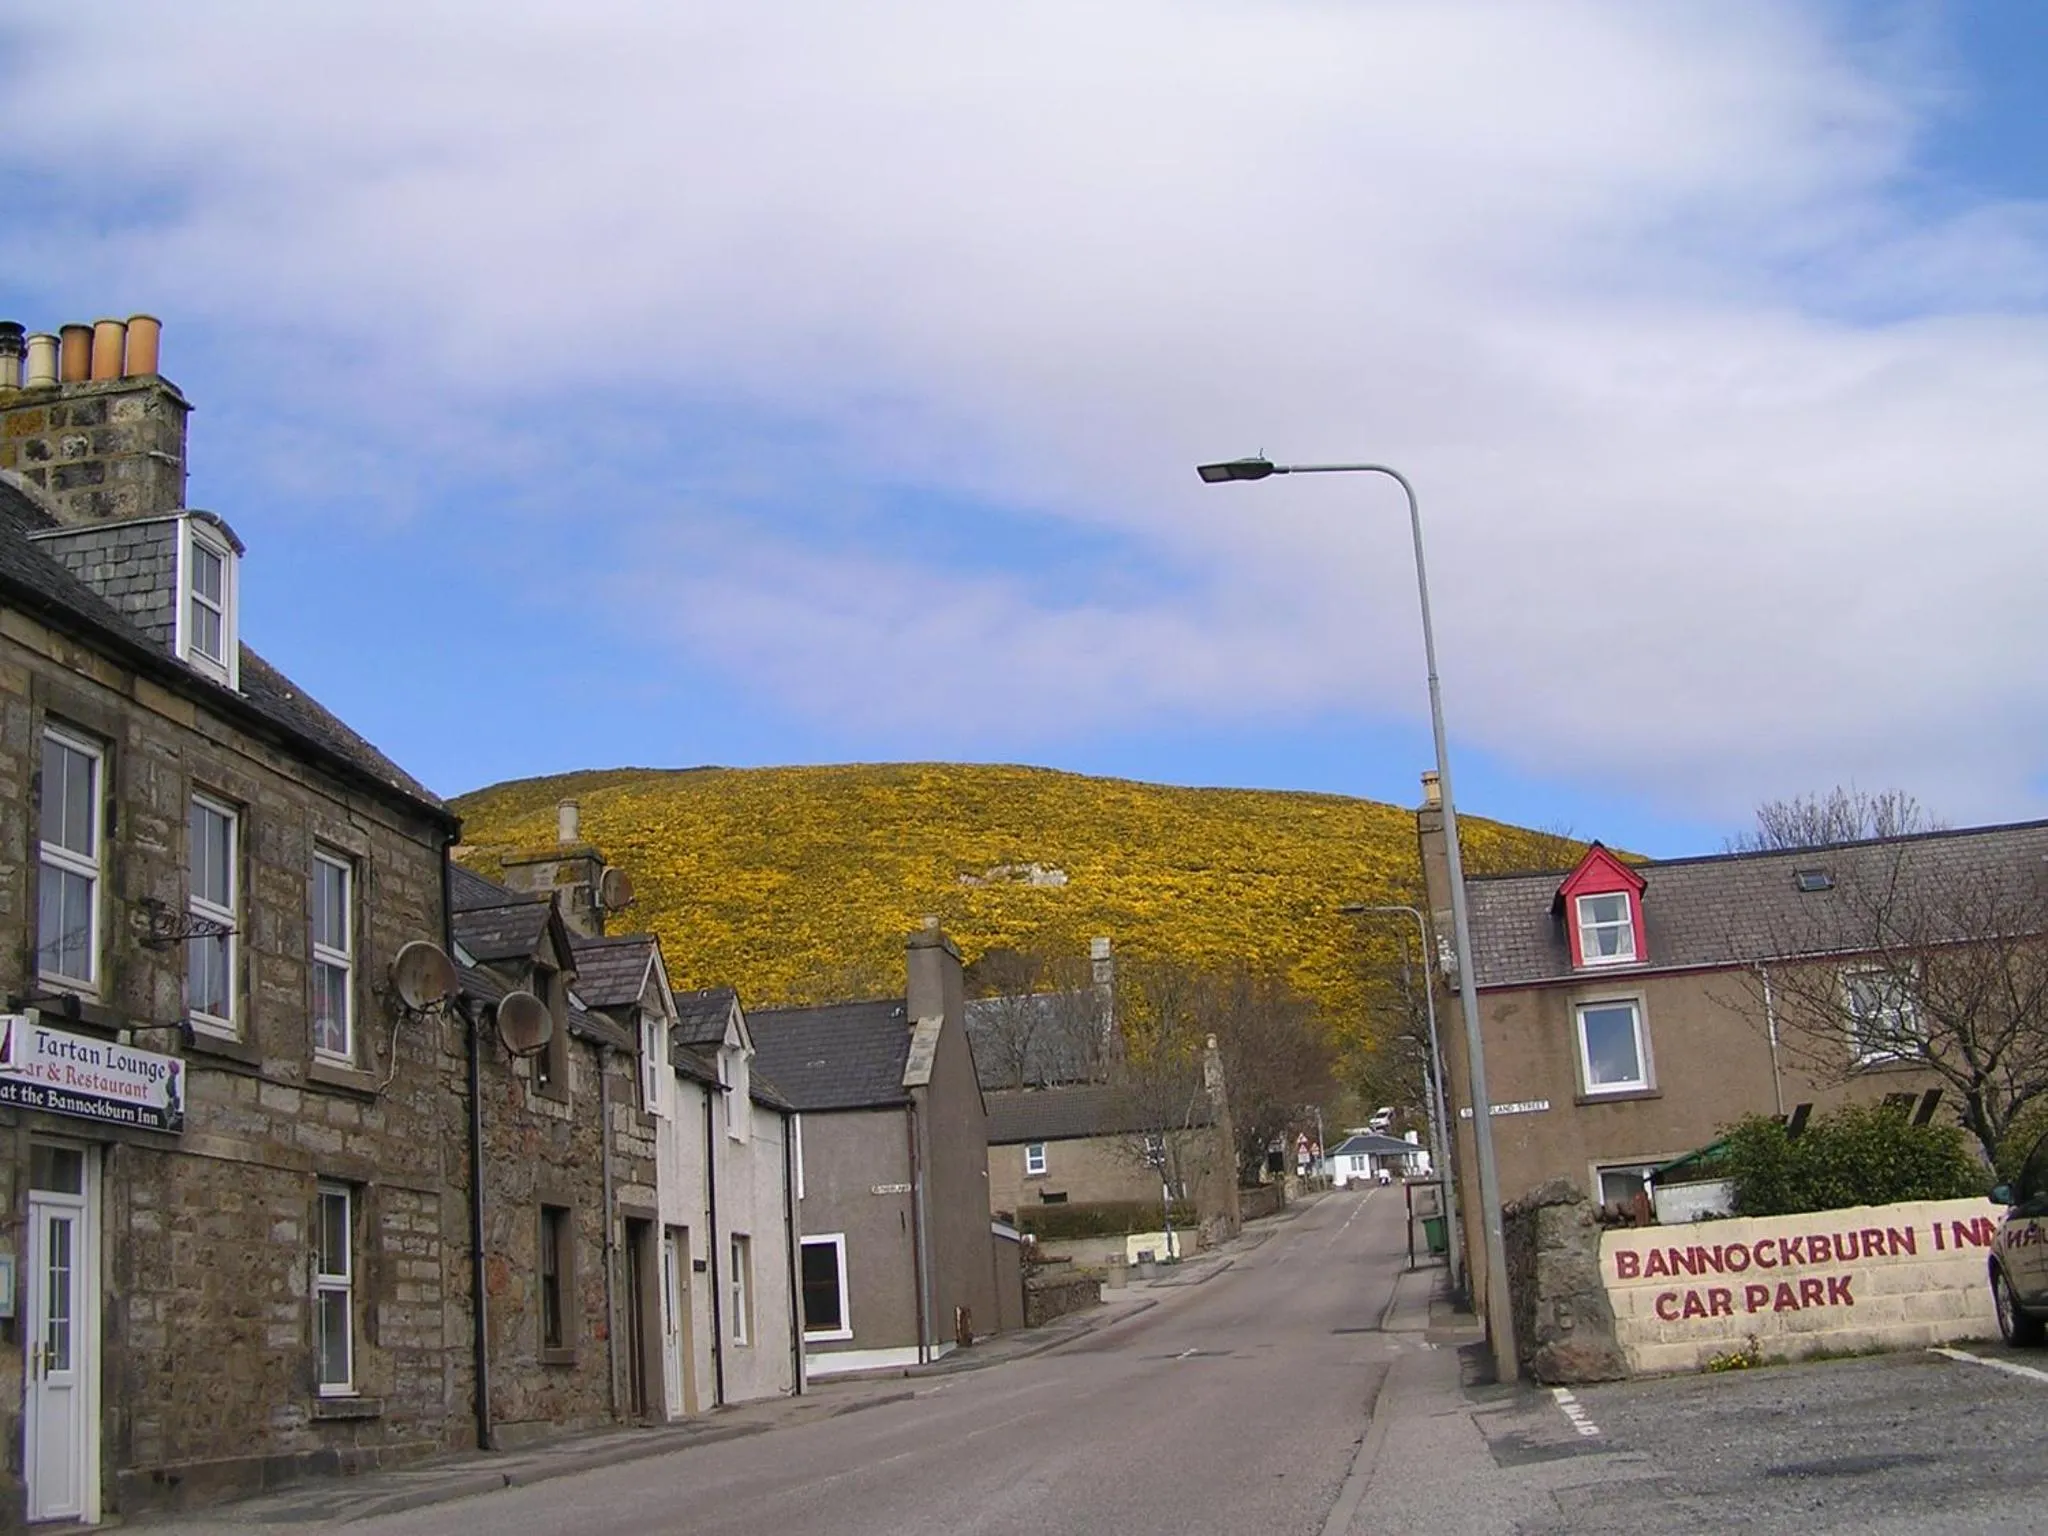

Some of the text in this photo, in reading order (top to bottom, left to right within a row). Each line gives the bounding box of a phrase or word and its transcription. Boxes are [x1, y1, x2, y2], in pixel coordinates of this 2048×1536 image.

[35, 1030, 166, 1083] Tartan Lounge
[47, 1062, 62, 1081] &
[65, 1065, 148, 1099] Restaurant
[0, 1084, 159, 1126] at the Bannockburn Inn
[1615, 1225, 1917, 1280] BANNOCKBURN
[1655, 1275, 1854, 1322] CAR PARK
